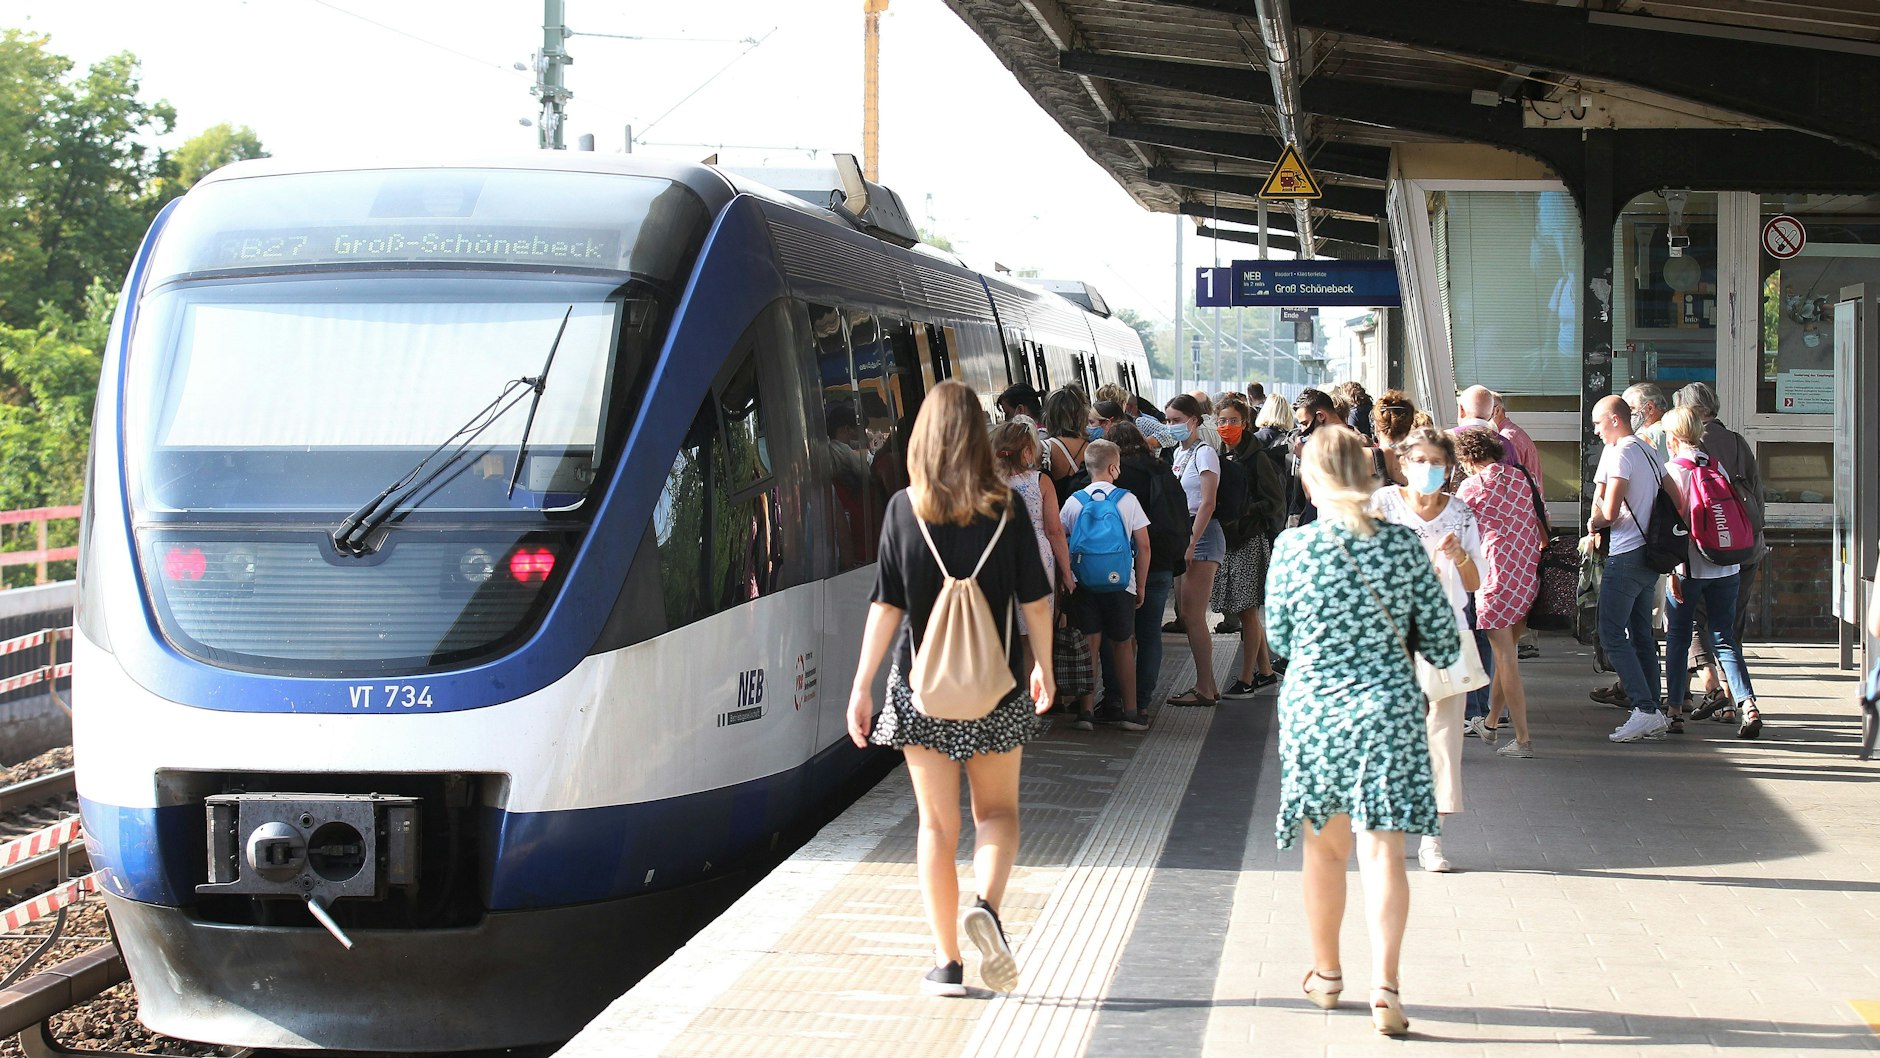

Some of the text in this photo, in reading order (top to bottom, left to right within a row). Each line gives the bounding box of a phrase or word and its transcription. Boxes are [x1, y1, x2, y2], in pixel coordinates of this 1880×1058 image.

[334, 233, 605, 258] Groß-Schönebeck
[1201, 268, 1213, 298] 1
[1243, 271, 1261, 281] NEB
[1275, 283, 1354, 294] Groß Schönebeck
[1283, 311, 1299, 319] Ende
[1711, 503, 1729, 531] PUMA
[349, 685, 434, 708] VT 734
[737, 668, 765, 708] NEB
